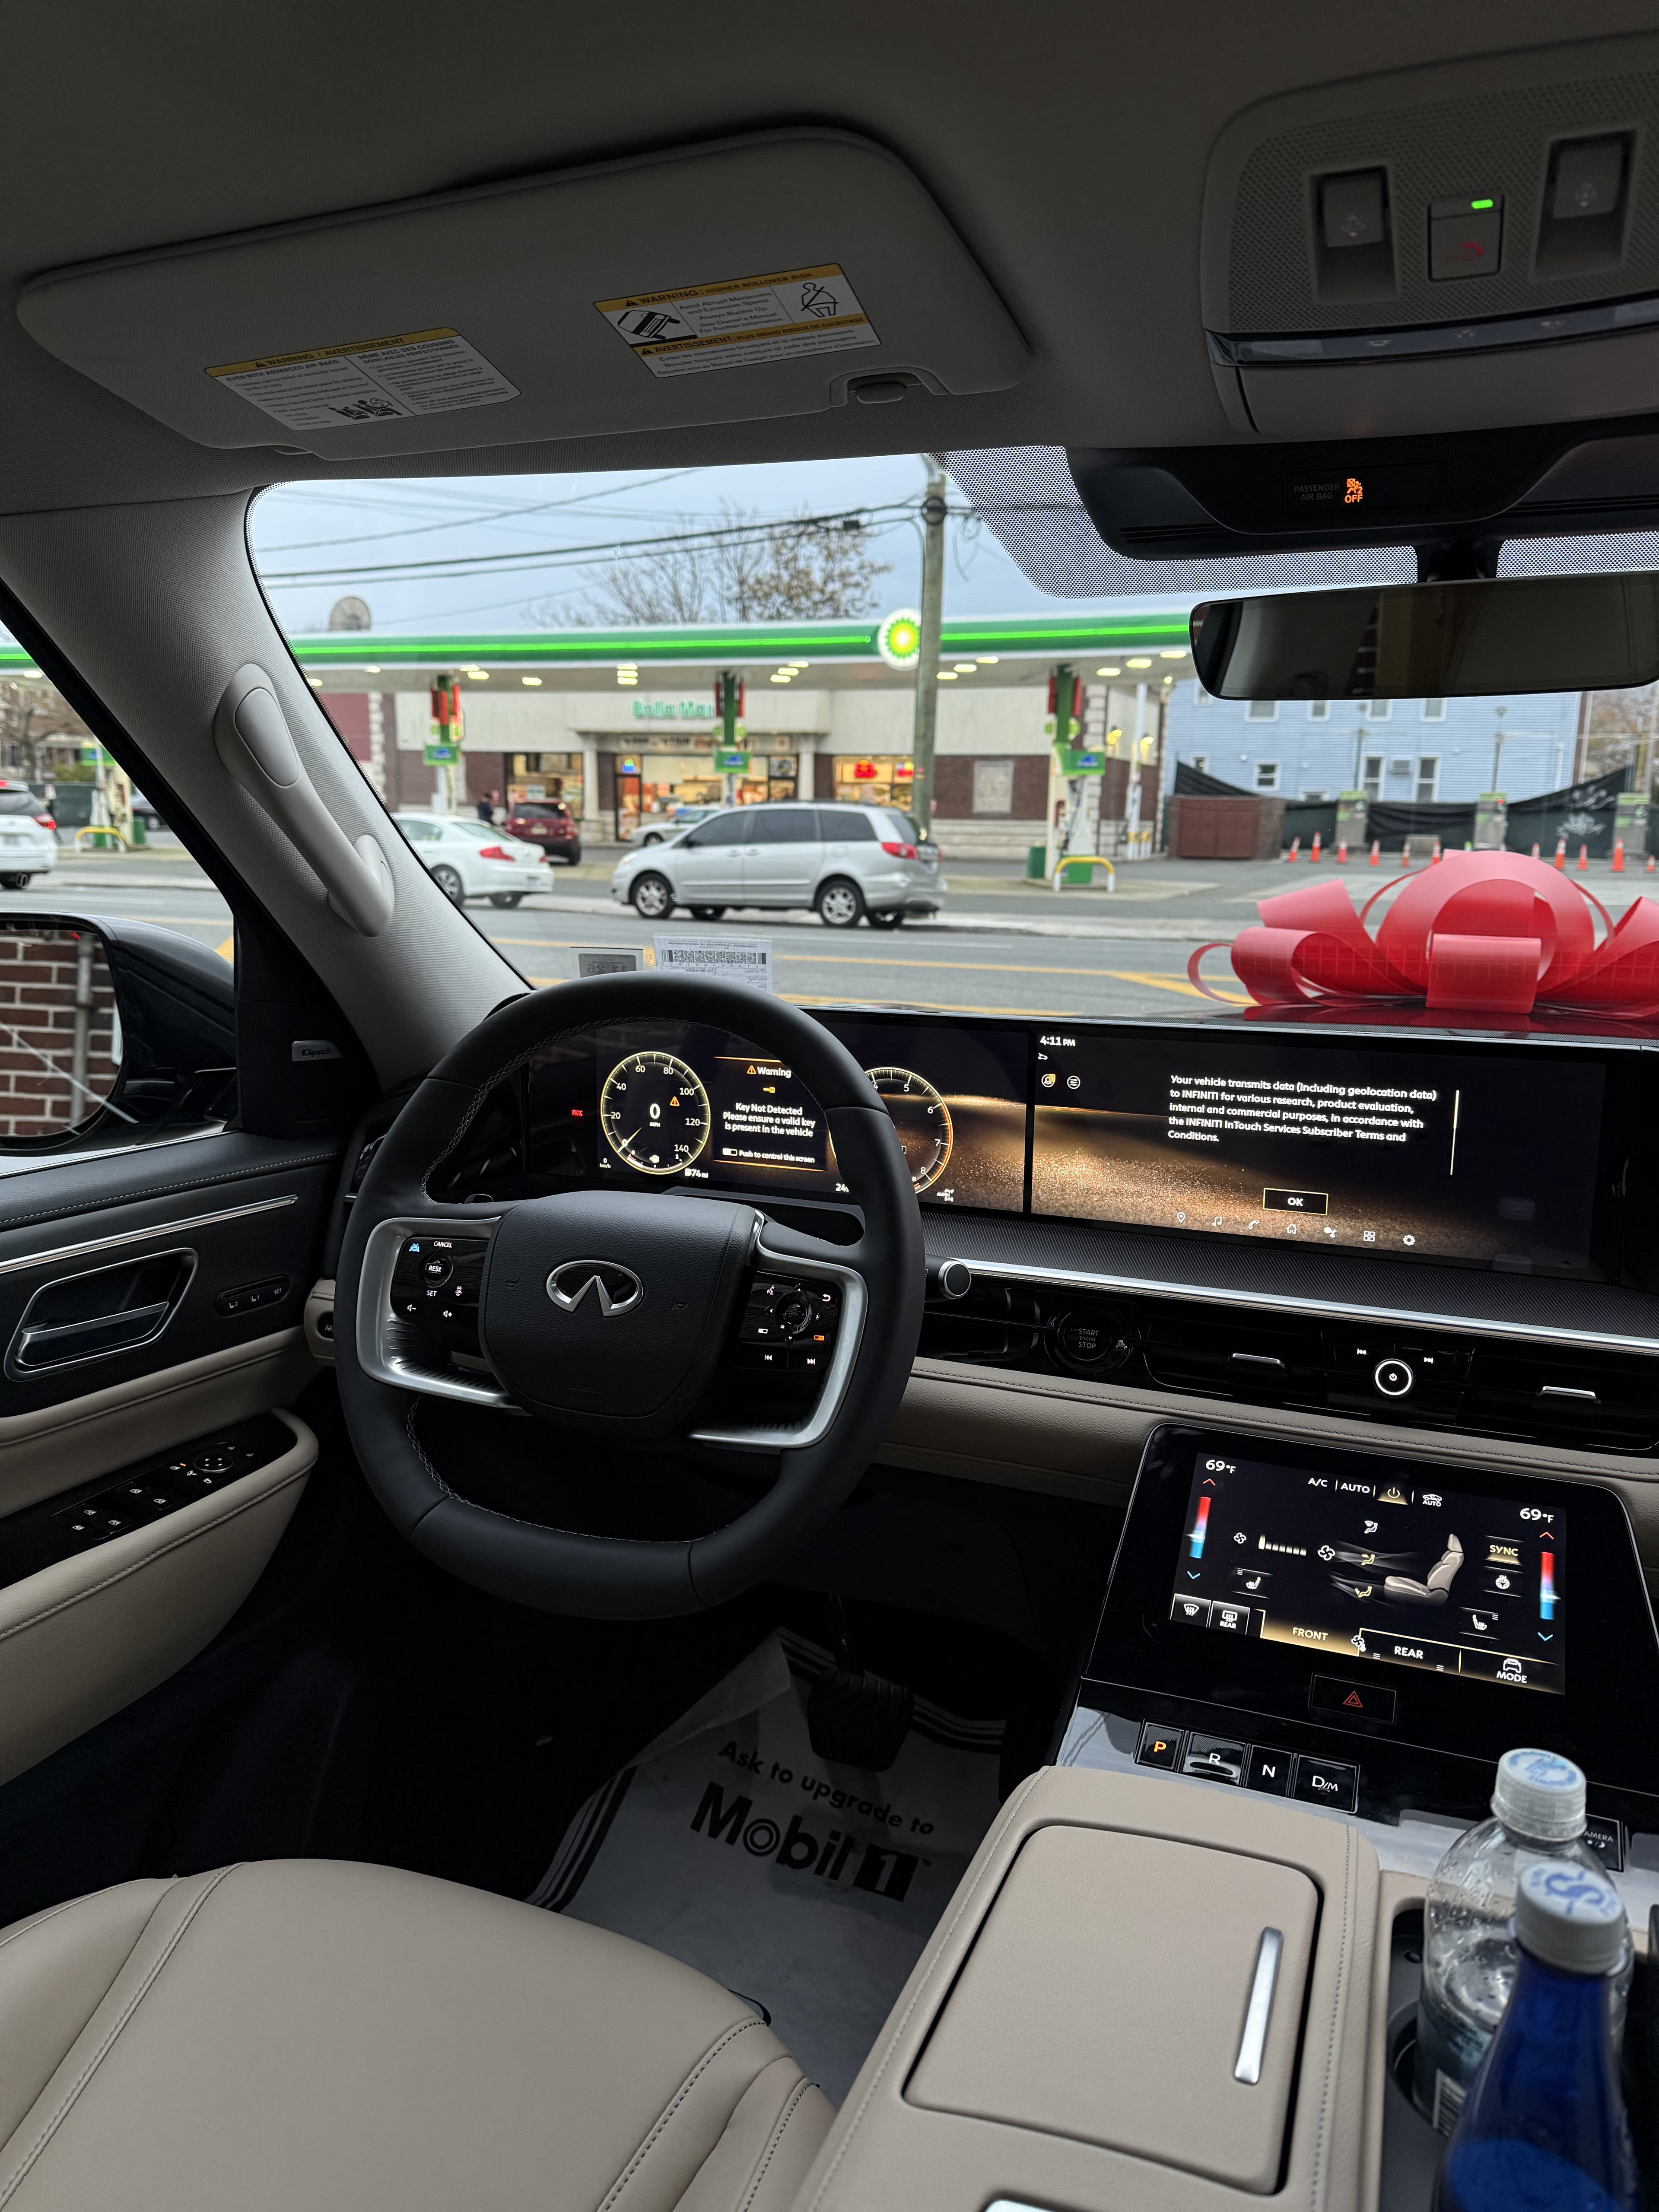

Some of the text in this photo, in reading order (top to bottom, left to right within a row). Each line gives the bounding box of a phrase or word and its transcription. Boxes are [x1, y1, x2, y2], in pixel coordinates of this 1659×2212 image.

[639, 289, 698, 304] WARNING
[706, 284, 740, 293] HIGHER
[743, 276, 788, 287] ROLLOVER
[655, 336, 731, 353] AVERTISSEMENT
[1294, 483, 1340, 493] PASSENGER
[1344, 494, 1363, 504] OFF
[1040, 1036, 1062, 1046] 4:11
[302, 1048, 332, 1057] Klipsch
[757, 1066, 791, 1078] Warning
[680, 1087, 694, 1096] 100
[1171, 1075, 1437, 1101] Your vehicle transmits data (including geolocation data)
[1170, 1090, 1414, 1114] to INFINITI for various research, product evaluation,
[650, 1103, 660, 1119] 0
[736, 1103, 802, 1115] Key Not Detected
[723, 1112, 747, 1121] Please
[748, 1115, 774, 1123] ensure
[782, 1117, 800, 1125] valid
[801, 1118, 815, 1128] key
[1170, 1103, 1424, 1128] internal and commercial purposes, in accordance with
[685, 1118, 700, 1126] 120
[725, 1122, 813, 1137] is present in the vehicle
[1169, 1116, 1406, 1142] the INFINITI InTouch Services Subscriber Terms and
[1168, 1130, 1219, 1141] Conditions.
[739, 1150, 753, 1158] Push
[762, 1152, 782, 1160] control
[1287, 1197, 1303, 1207] OK
[1206, 1459, 1236, 1473] 69°F
[1308, 1478, 1328, 1487] A/C
[1341, 1483, 1370, 1494] AUTO
[1520, 1508, 1554, 1523] 69°F
[1490, 1545, 1518, 1556] SYNC
[1220, 1621, 1236, 1629] REAR
[1293, 1627, 1328, 1641] FRONT
[1394, 1646, 1423, 1659] REAR
[1497, 1671, 1527, 1683] MODE
[1154, 1741, 1167, 1752] P
[1209, 1753, 1221, 1765] R
[1262, 1764, 1276, 1778] N
[718, 1741, 934, 1835] Ask to upgrade to
[1312, 1775, 1338, 1791] D/M
[690, 1781, 856, 1881] Mobil
[1583, 1831, 1614, 1842] AMERA
